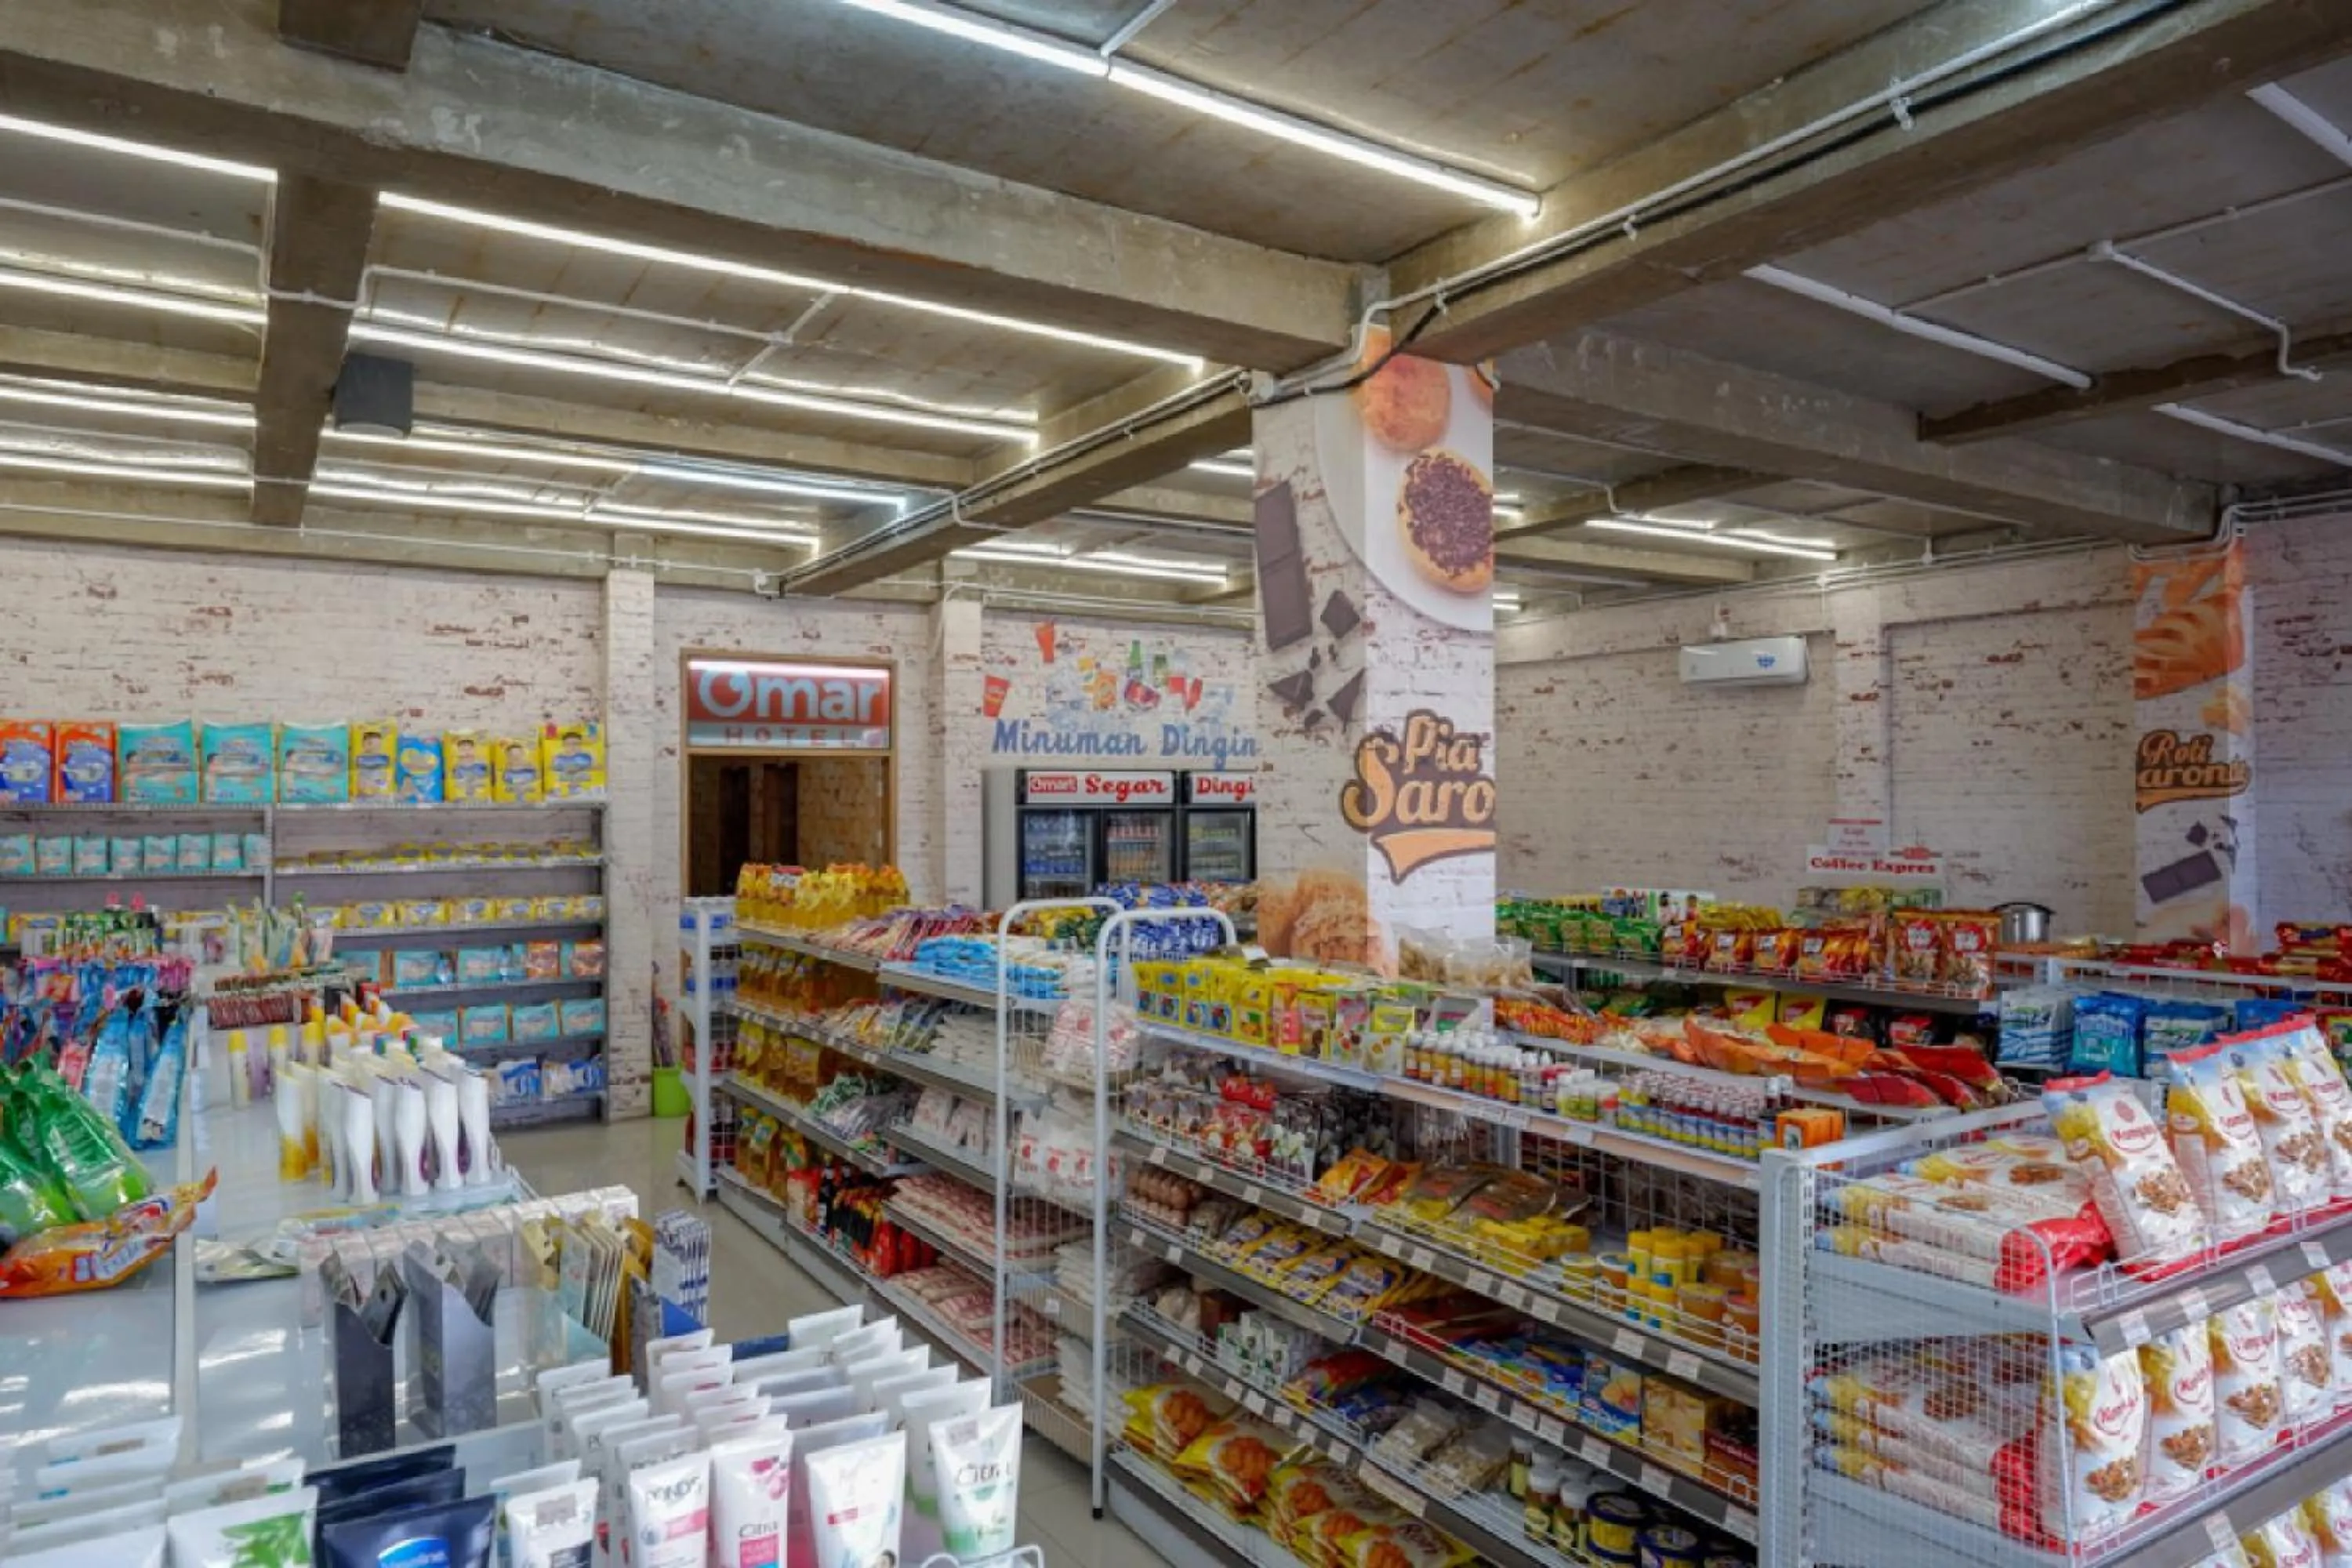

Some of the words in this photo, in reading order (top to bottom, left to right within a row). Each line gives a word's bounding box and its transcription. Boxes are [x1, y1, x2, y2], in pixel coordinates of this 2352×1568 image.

[697, 667, 882, 723] Omar
[724, 725, 856, 746] HOTEL
[992, 718, 1148, 756] Minuman
[1160, 722, 1258, 771] Dingin
[1401, 714, 1479, 775] Pia
[2141, 730, 2211, 768] Roti
[1084, 774, 1168, 803] Segar
[1810, 856, 1867, 871] Coffee
[1871, 858, 1936, 874] Expres
